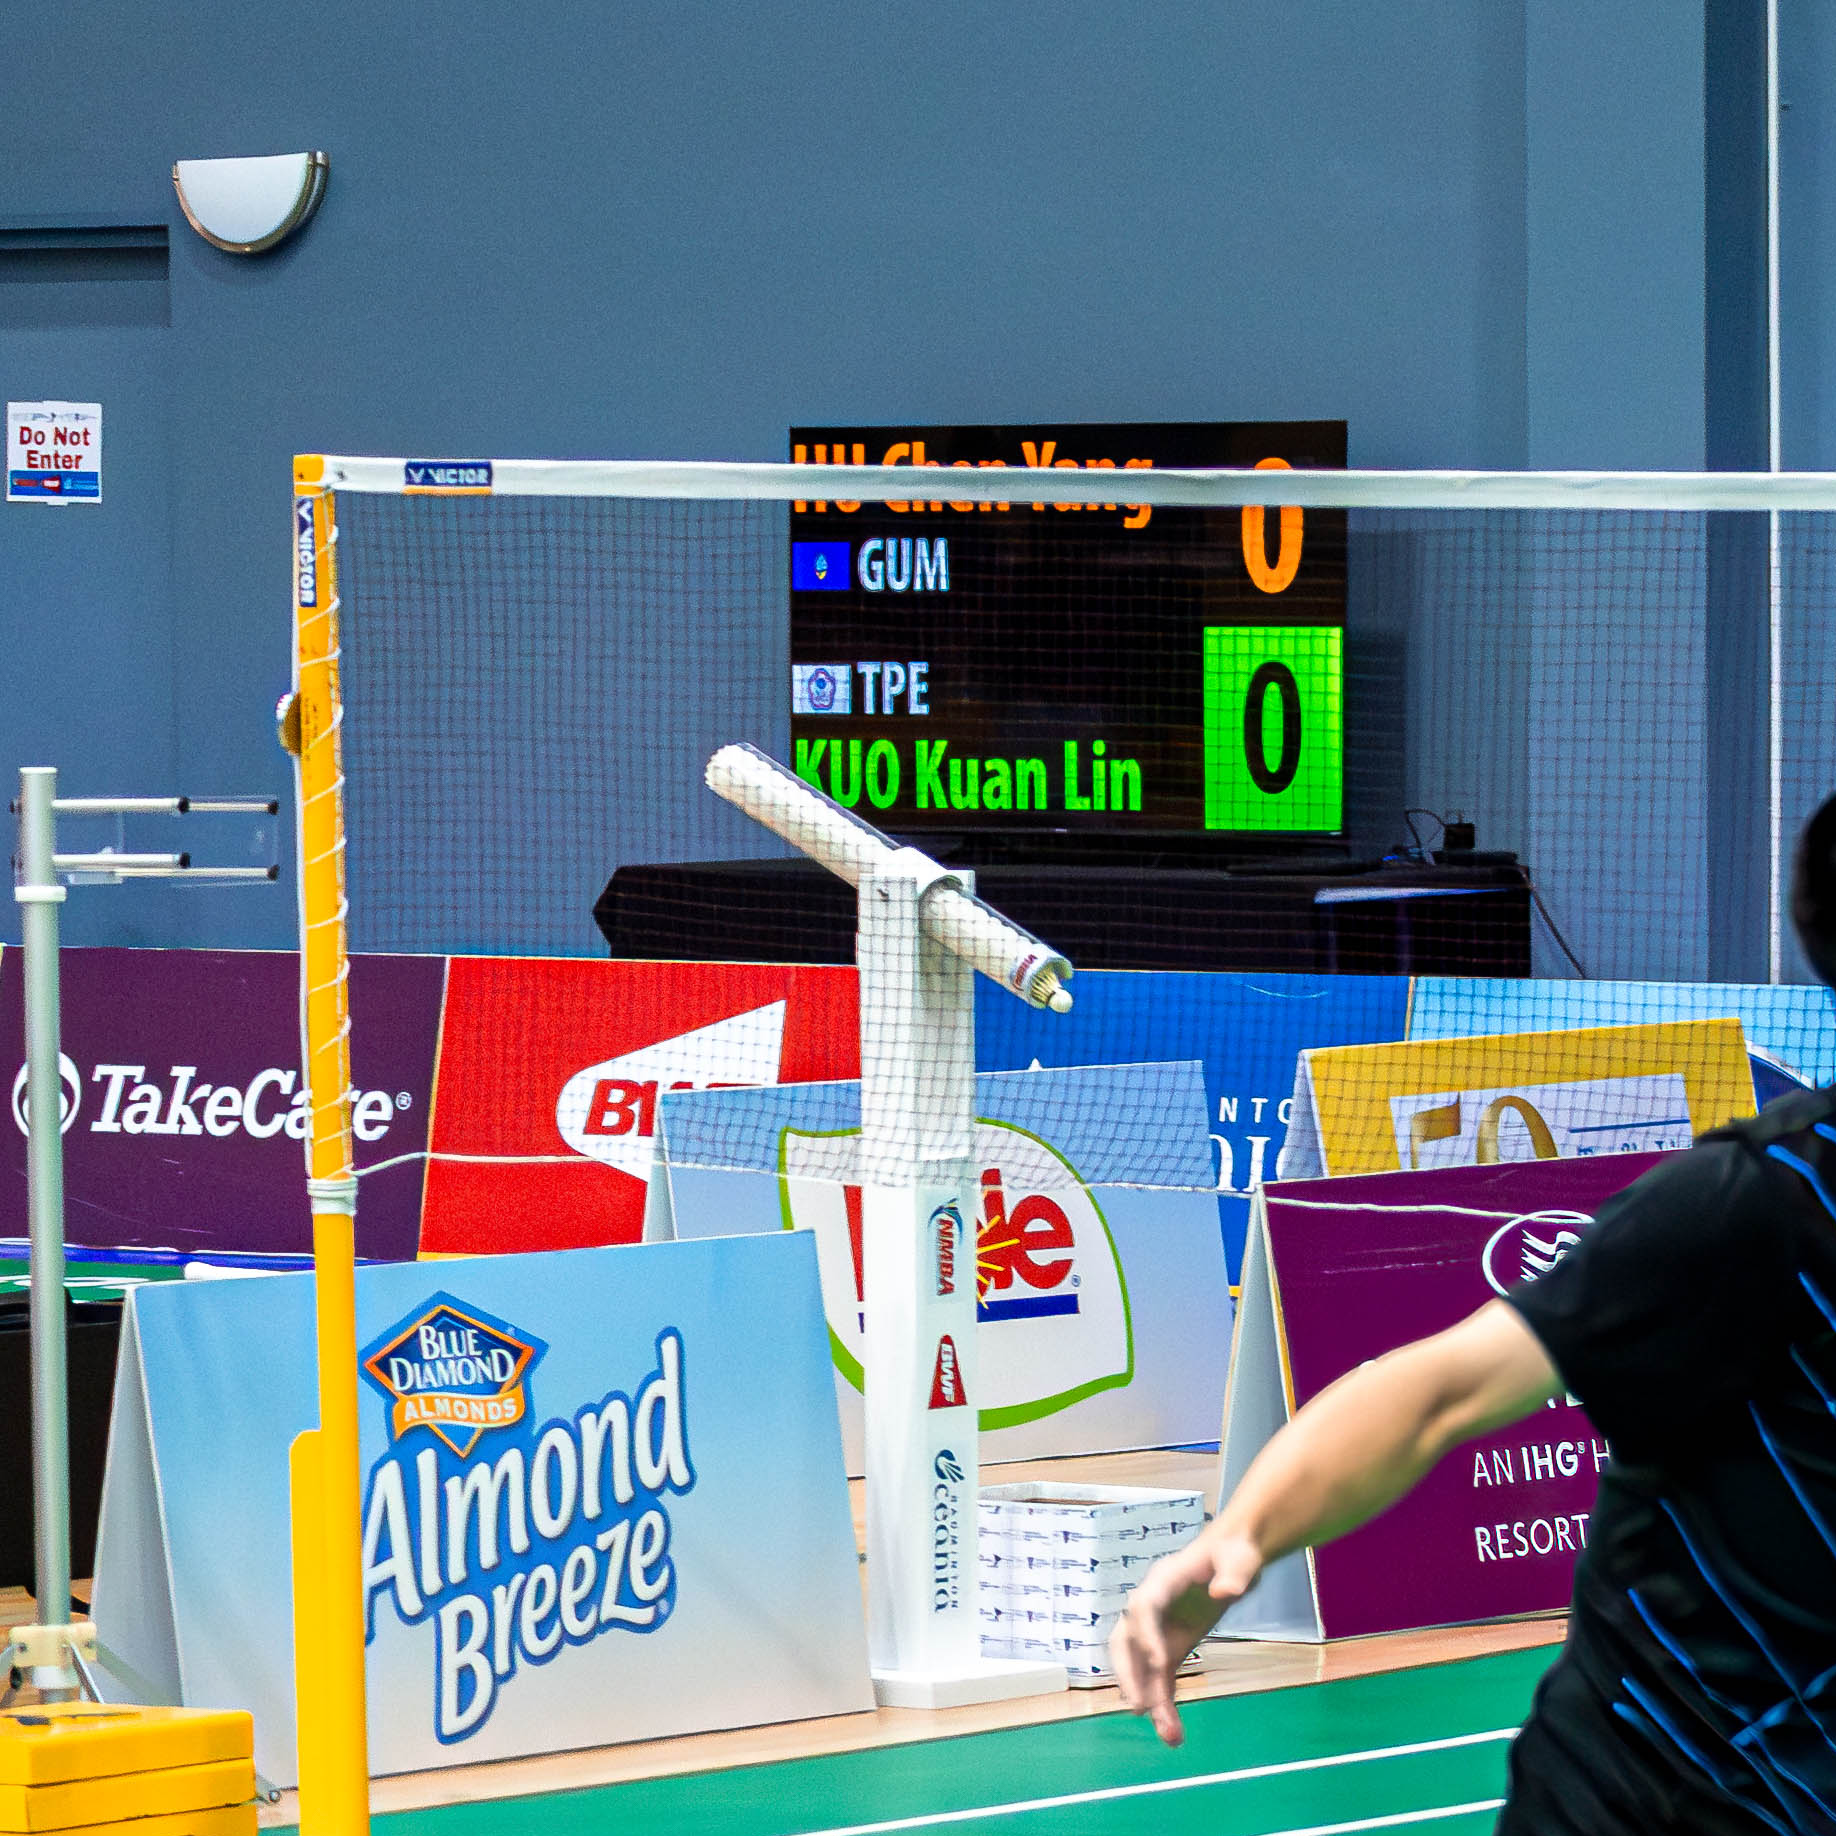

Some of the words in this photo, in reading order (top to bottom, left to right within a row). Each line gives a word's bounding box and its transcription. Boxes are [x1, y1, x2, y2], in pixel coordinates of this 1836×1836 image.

[19, 426, 46, 445] Do
[53, 426, 91, 446] Not
[26, 450, 83, 469] Enter
[429, 468, 489, 484] VICTOR
[1240, 456, 1305, 595] 0
[299, 525, 315, 604] VICTOR
[857, 537, 951, 593] GUM
[857, 660, 931, 716] TPE
[1243, 660, 1302, 795] 0
[795, 738, 901, 811] KUO
[915, 738, 1048, 811] Kuan
[1063, 738, 1143, 812] Lin
[419, 1324, 483, 1359] BLUE
[391, 1348, 517, 1392] DIAMOND
[940, 1342, 955, 1404] BWF
[402, 1396, 518, 1424] ALMONDS
[363, 1334, 692, 1617] Almond
[1473, 1448, 1515, 1488] AN
[440, 1510, 672, 1736] Breeze
